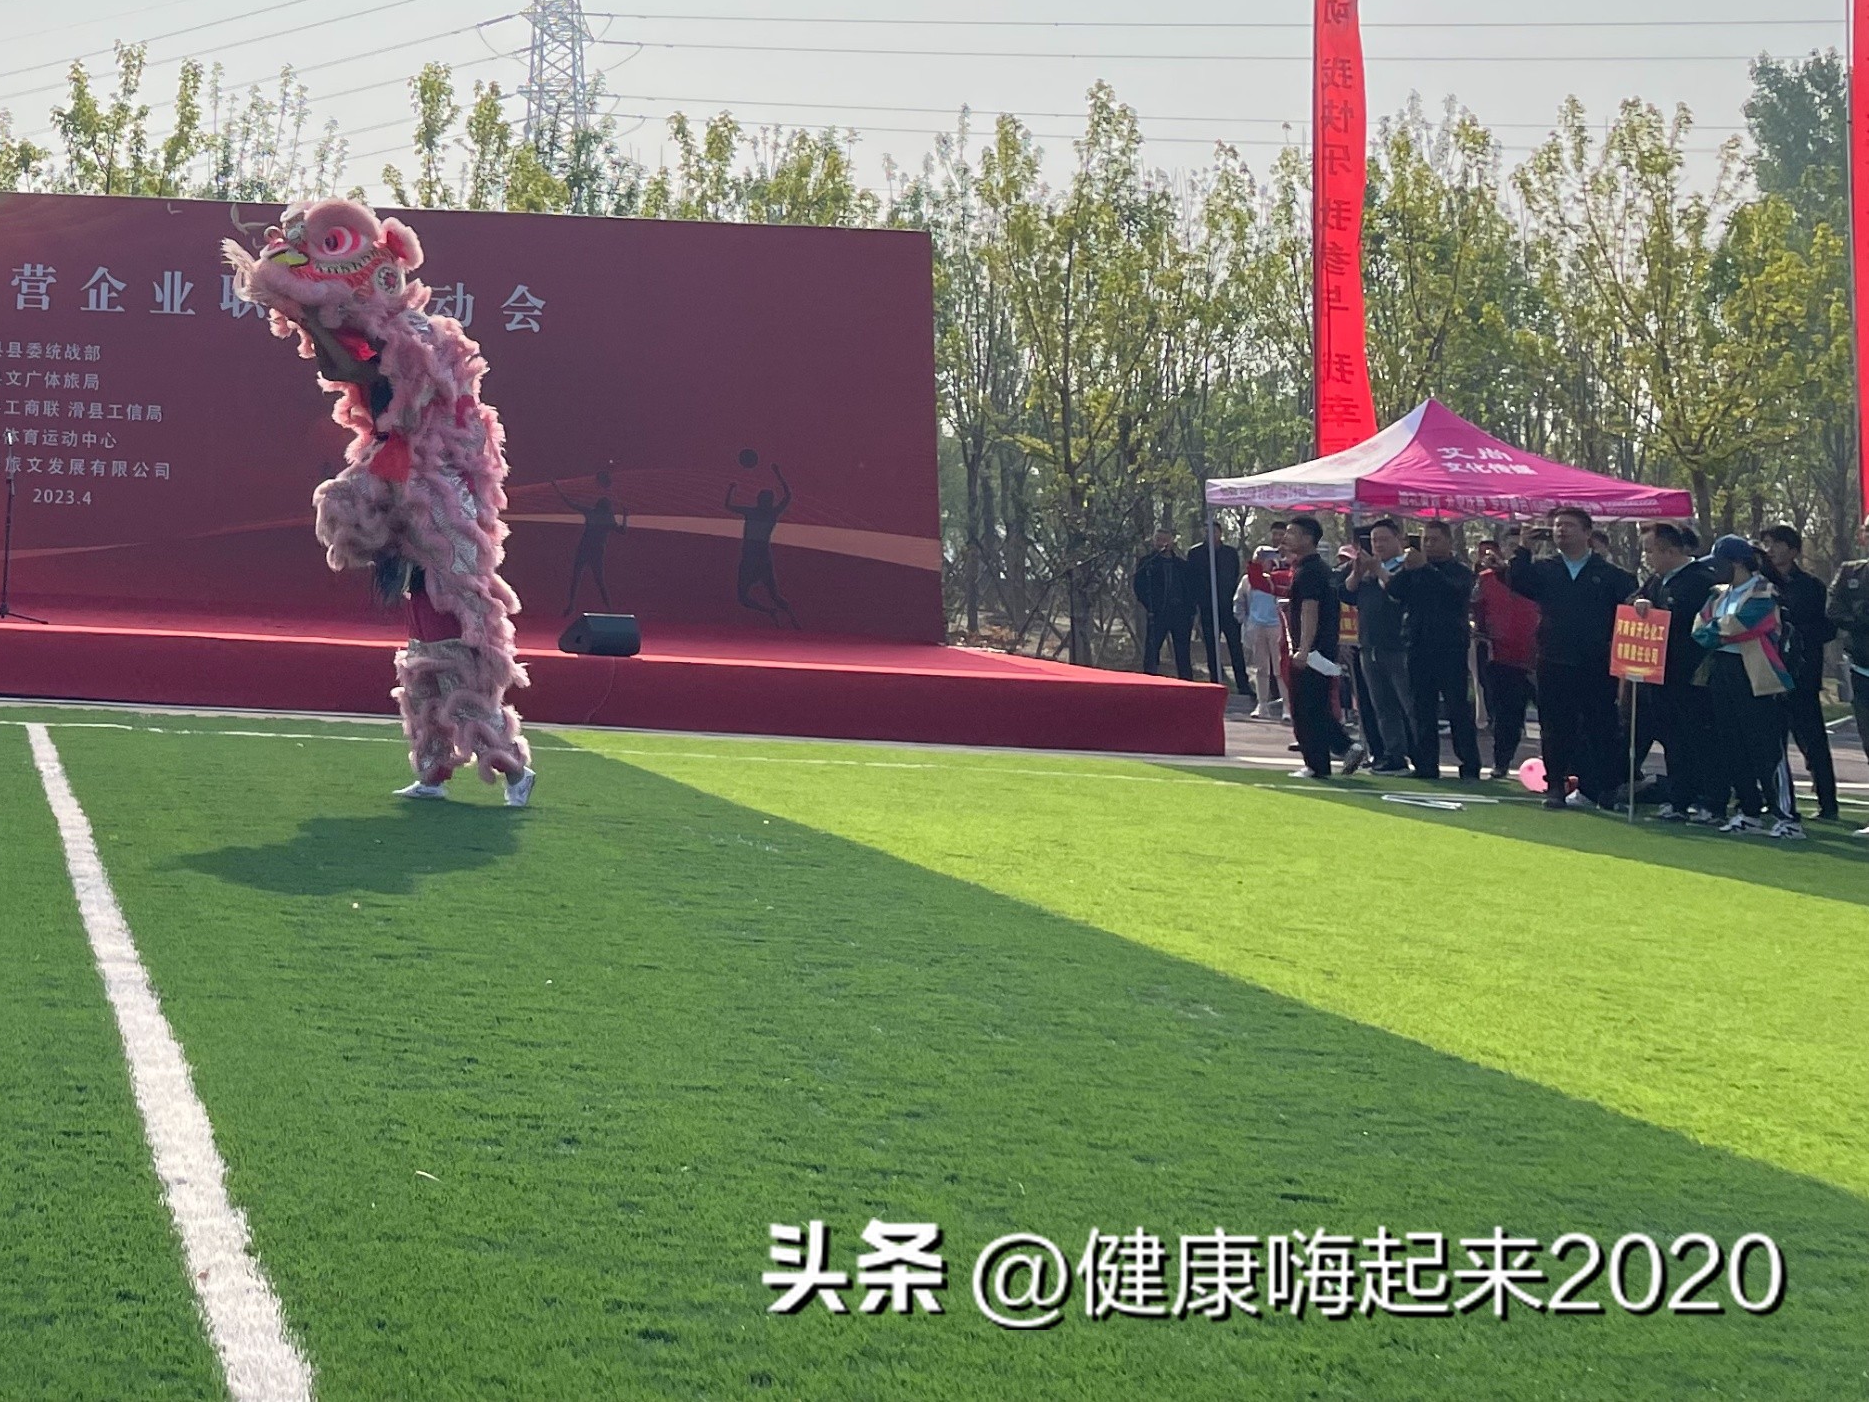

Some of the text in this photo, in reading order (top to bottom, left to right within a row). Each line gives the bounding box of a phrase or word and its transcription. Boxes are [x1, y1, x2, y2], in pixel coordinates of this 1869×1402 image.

[68, 400, 163, 422] 滑县工信局
[33, 487, 93, 505] 2023.4
